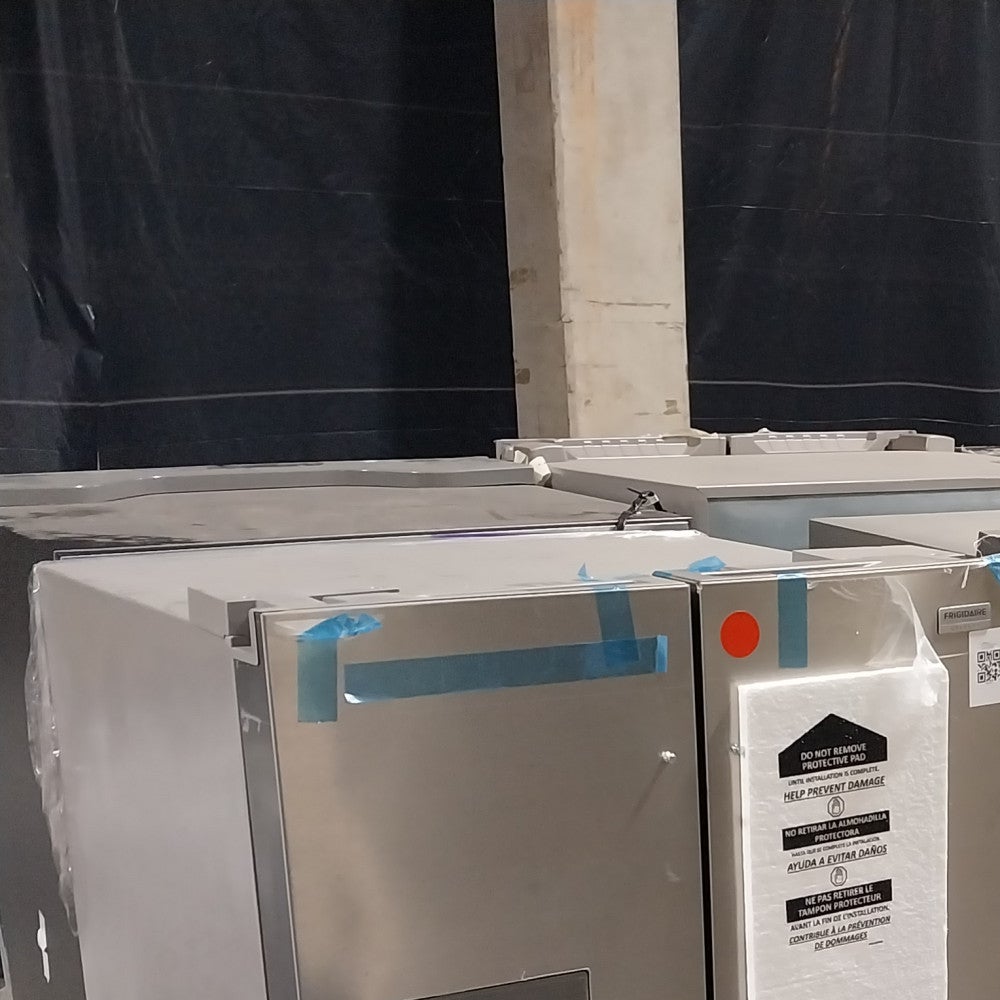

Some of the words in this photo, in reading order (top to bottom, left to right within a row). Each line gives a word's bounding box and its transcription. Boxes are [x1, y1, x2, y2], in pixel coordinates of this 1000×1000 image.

[944, 608, 987, 620] FRIGIDAIRE
[801, 751, 813, 761] DO
[815, 748, 831, 758] NOT
[834, 743, 866, 755] REMOVE
[803, 756, 848, 770] PROTECTIVE
[851, 753, 866, 763] PAD
[784, 789, 805, 801] HELP
[808, 782, 845, 797] PREVENT
[848, 776, 885, 790] DAMAGE
[786, 829, 796, 837] NO
[798, 823, 827, 835] RETIRAR
[838, 812, 887, 828] ALMOHADILLA
[815, 828, 860, 843] PROTECTORA
[787, 858, 816, 872] AYUDA
[819, 856, 824, 866] A
[827, 850, 855, 864] EVITAR
[858, 843, 887, 858] DAÑOS
[799, 903, 831, 917] TAMPON
[834, 893, 881, 910] PROTECTEUR
[805, 896, 815, 906] NE
[817, 893, 831, 903] PAS
[833, 886, 863, 900] RETIRER
[865, 884, 873, 893] LE
[815, 941, 823, 950] DE
[825, 931, 867, 948] DOMMAGES
